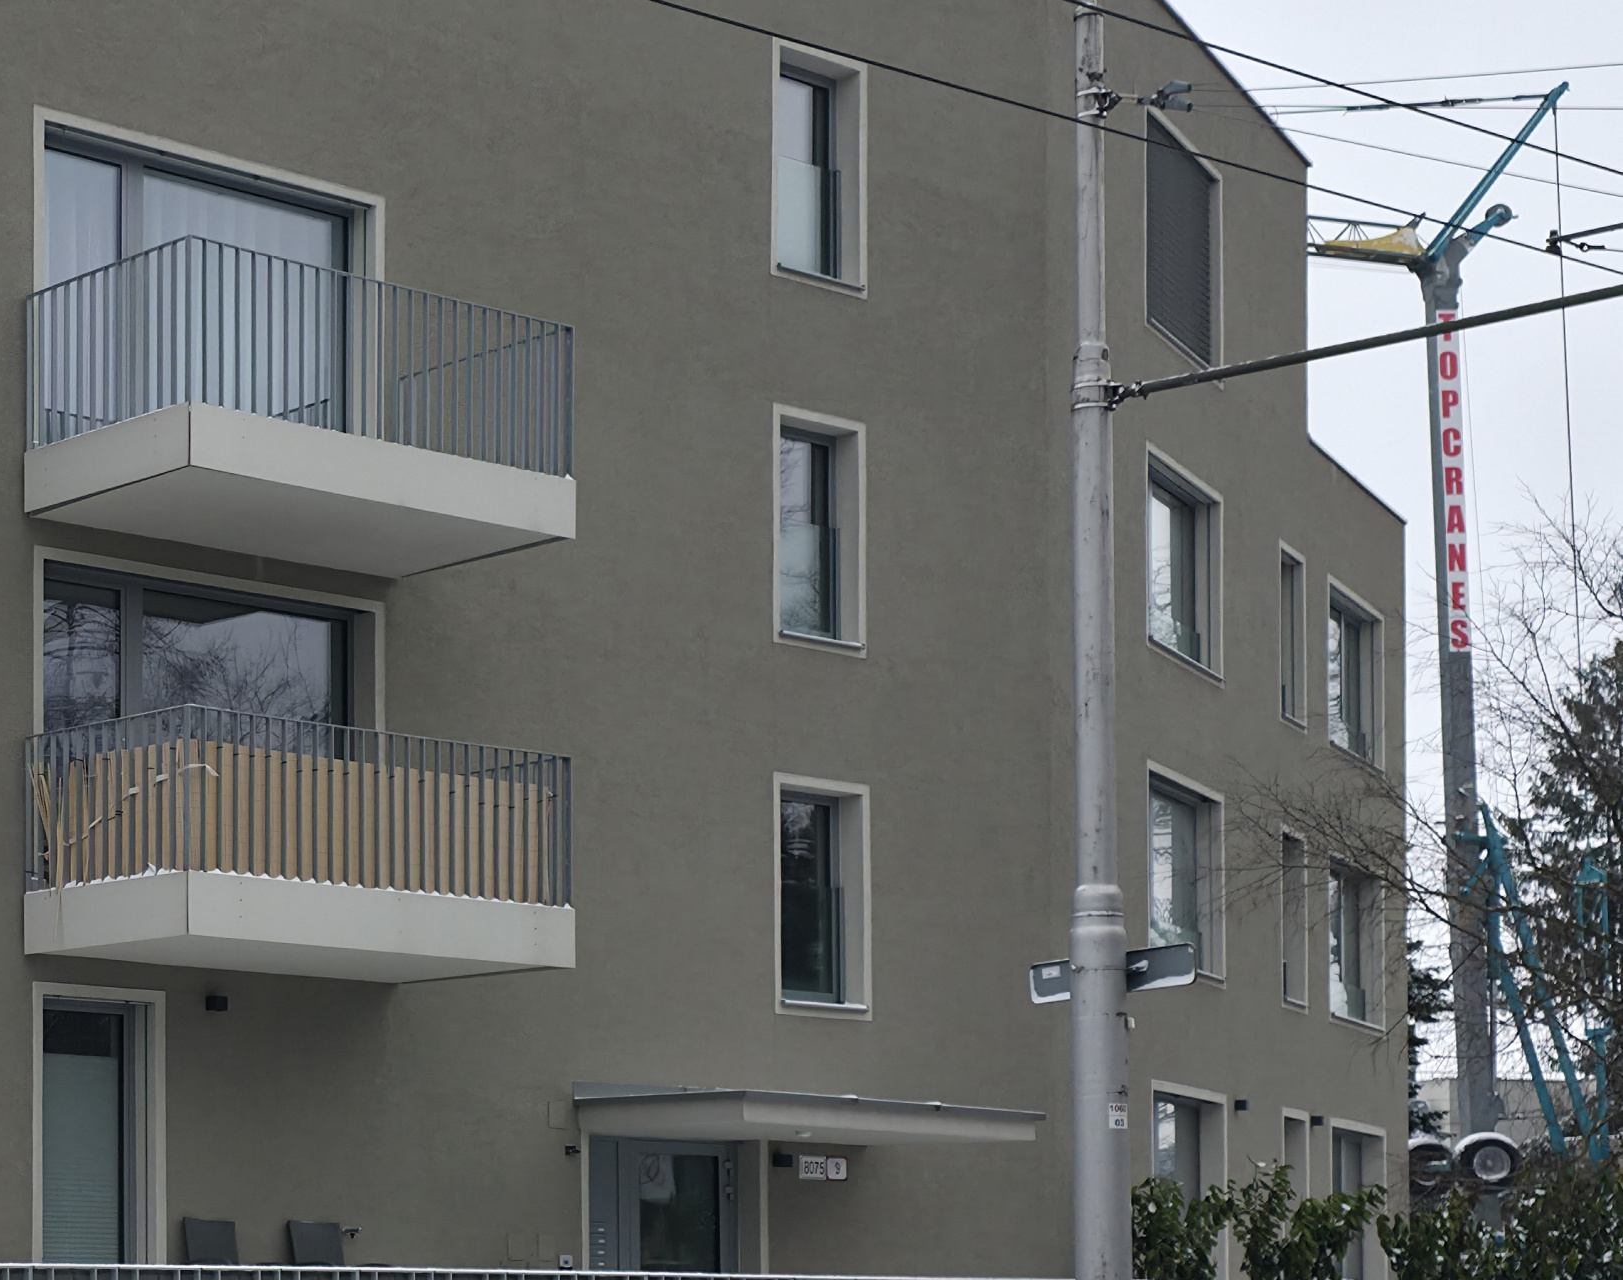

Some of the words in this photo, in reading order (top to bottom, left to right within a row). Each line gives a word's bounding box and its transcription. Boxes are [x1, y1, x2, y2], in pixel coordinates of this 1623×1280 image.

[1438, 313, 1469, 649] TOPCRANES
[804, 1161, 825, 1175] 8075
[835, 1161, 841, 1175] 9
